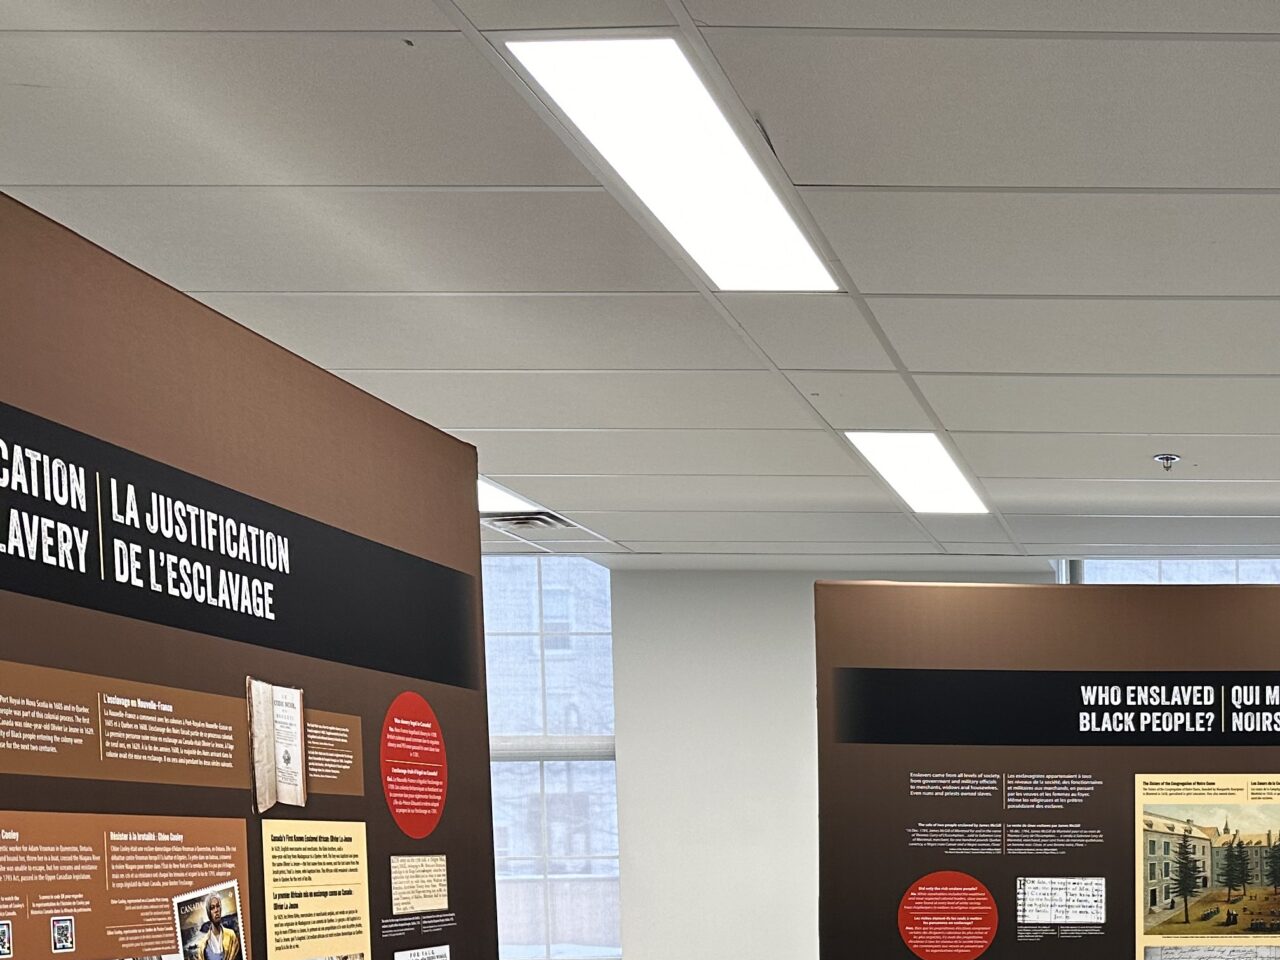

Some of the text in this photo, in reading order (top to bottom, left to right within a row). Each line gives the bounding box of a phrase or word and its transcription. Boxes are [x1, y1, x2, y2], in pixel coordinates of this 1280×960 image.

[111, 478, 290, 574] LA JUSTIFICATION
[0, 508, 88, 573] AVERY
[114, 538, 275, 620] DE L'ESCLAVAGE
[1081, 686, 1214, 706] WHO ENSLAVED
[1232, 686, 1259, 708] QUI
[1079, 712, 1214, 732] BLACK PEOPLE?
[1, 830, 19, 841] Cooley
